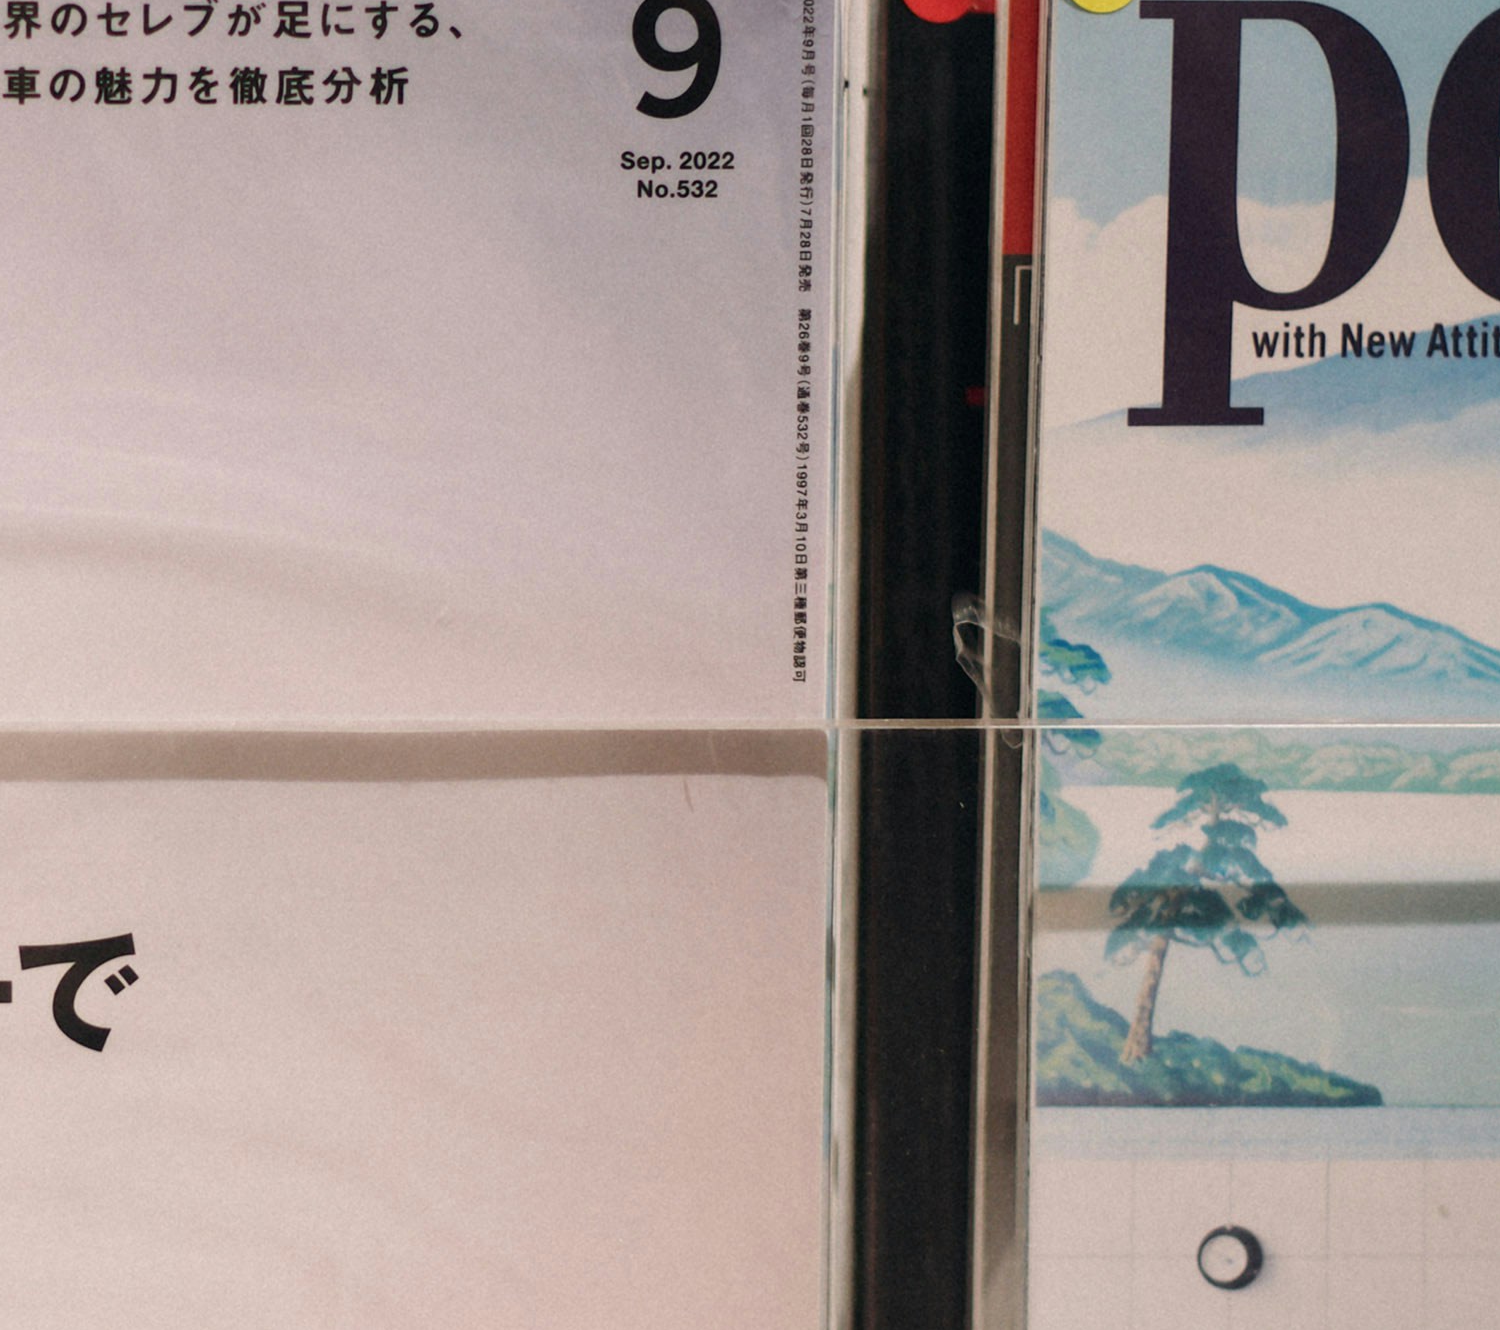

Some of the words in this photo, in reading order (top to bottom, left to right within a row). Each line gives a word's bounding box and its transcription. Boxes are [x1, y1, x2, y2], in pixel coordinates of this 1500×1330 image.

[619, 151, 672, 174] Sep.
[678, 150, 736, 171] 2022
[636, 179, 719, 200] No.532
[1252, 322, 1328, 359] with
[1340, 323, 1415, 359] New
